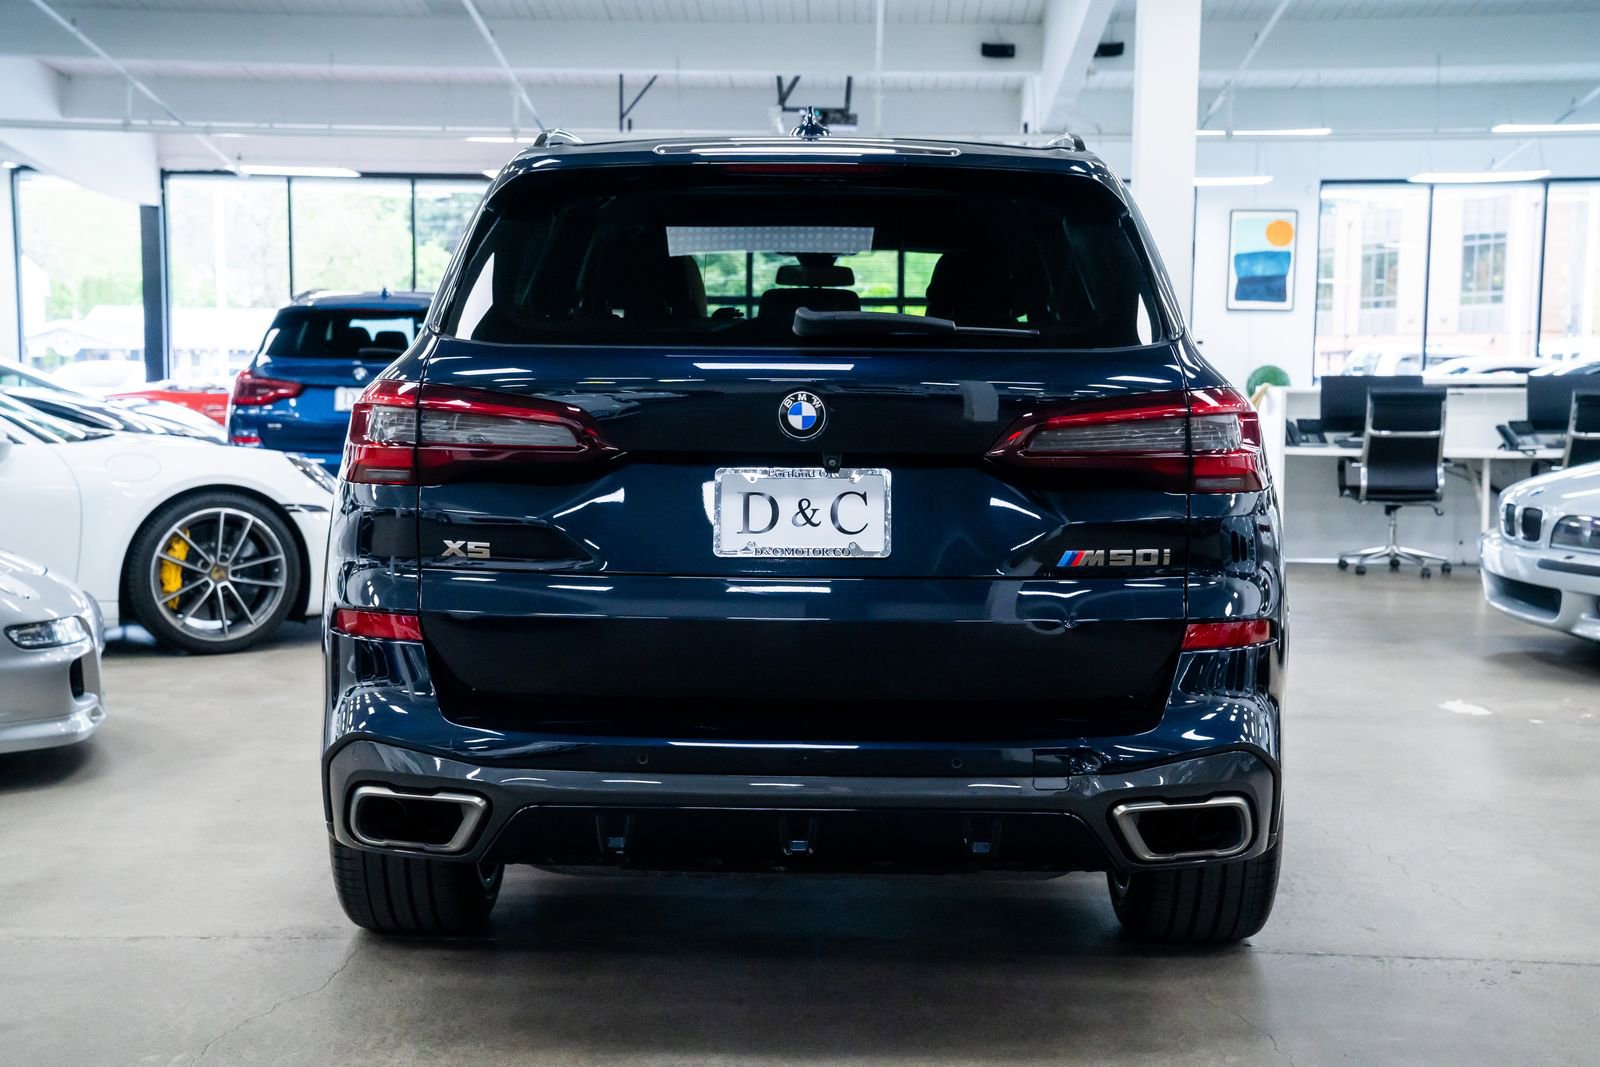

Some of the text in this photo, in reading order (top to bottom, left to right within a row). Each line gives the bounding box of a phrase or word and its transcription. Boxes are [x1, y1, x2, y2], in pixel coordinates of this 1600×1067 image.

[784, 394, 821, 408] BMW
[736, 491, 868, 535] D & C
[441, 540, 490, 558] X5
[784, 547, 829, 557] MOTOR
[1078, 549, 1171, 566] M50i
